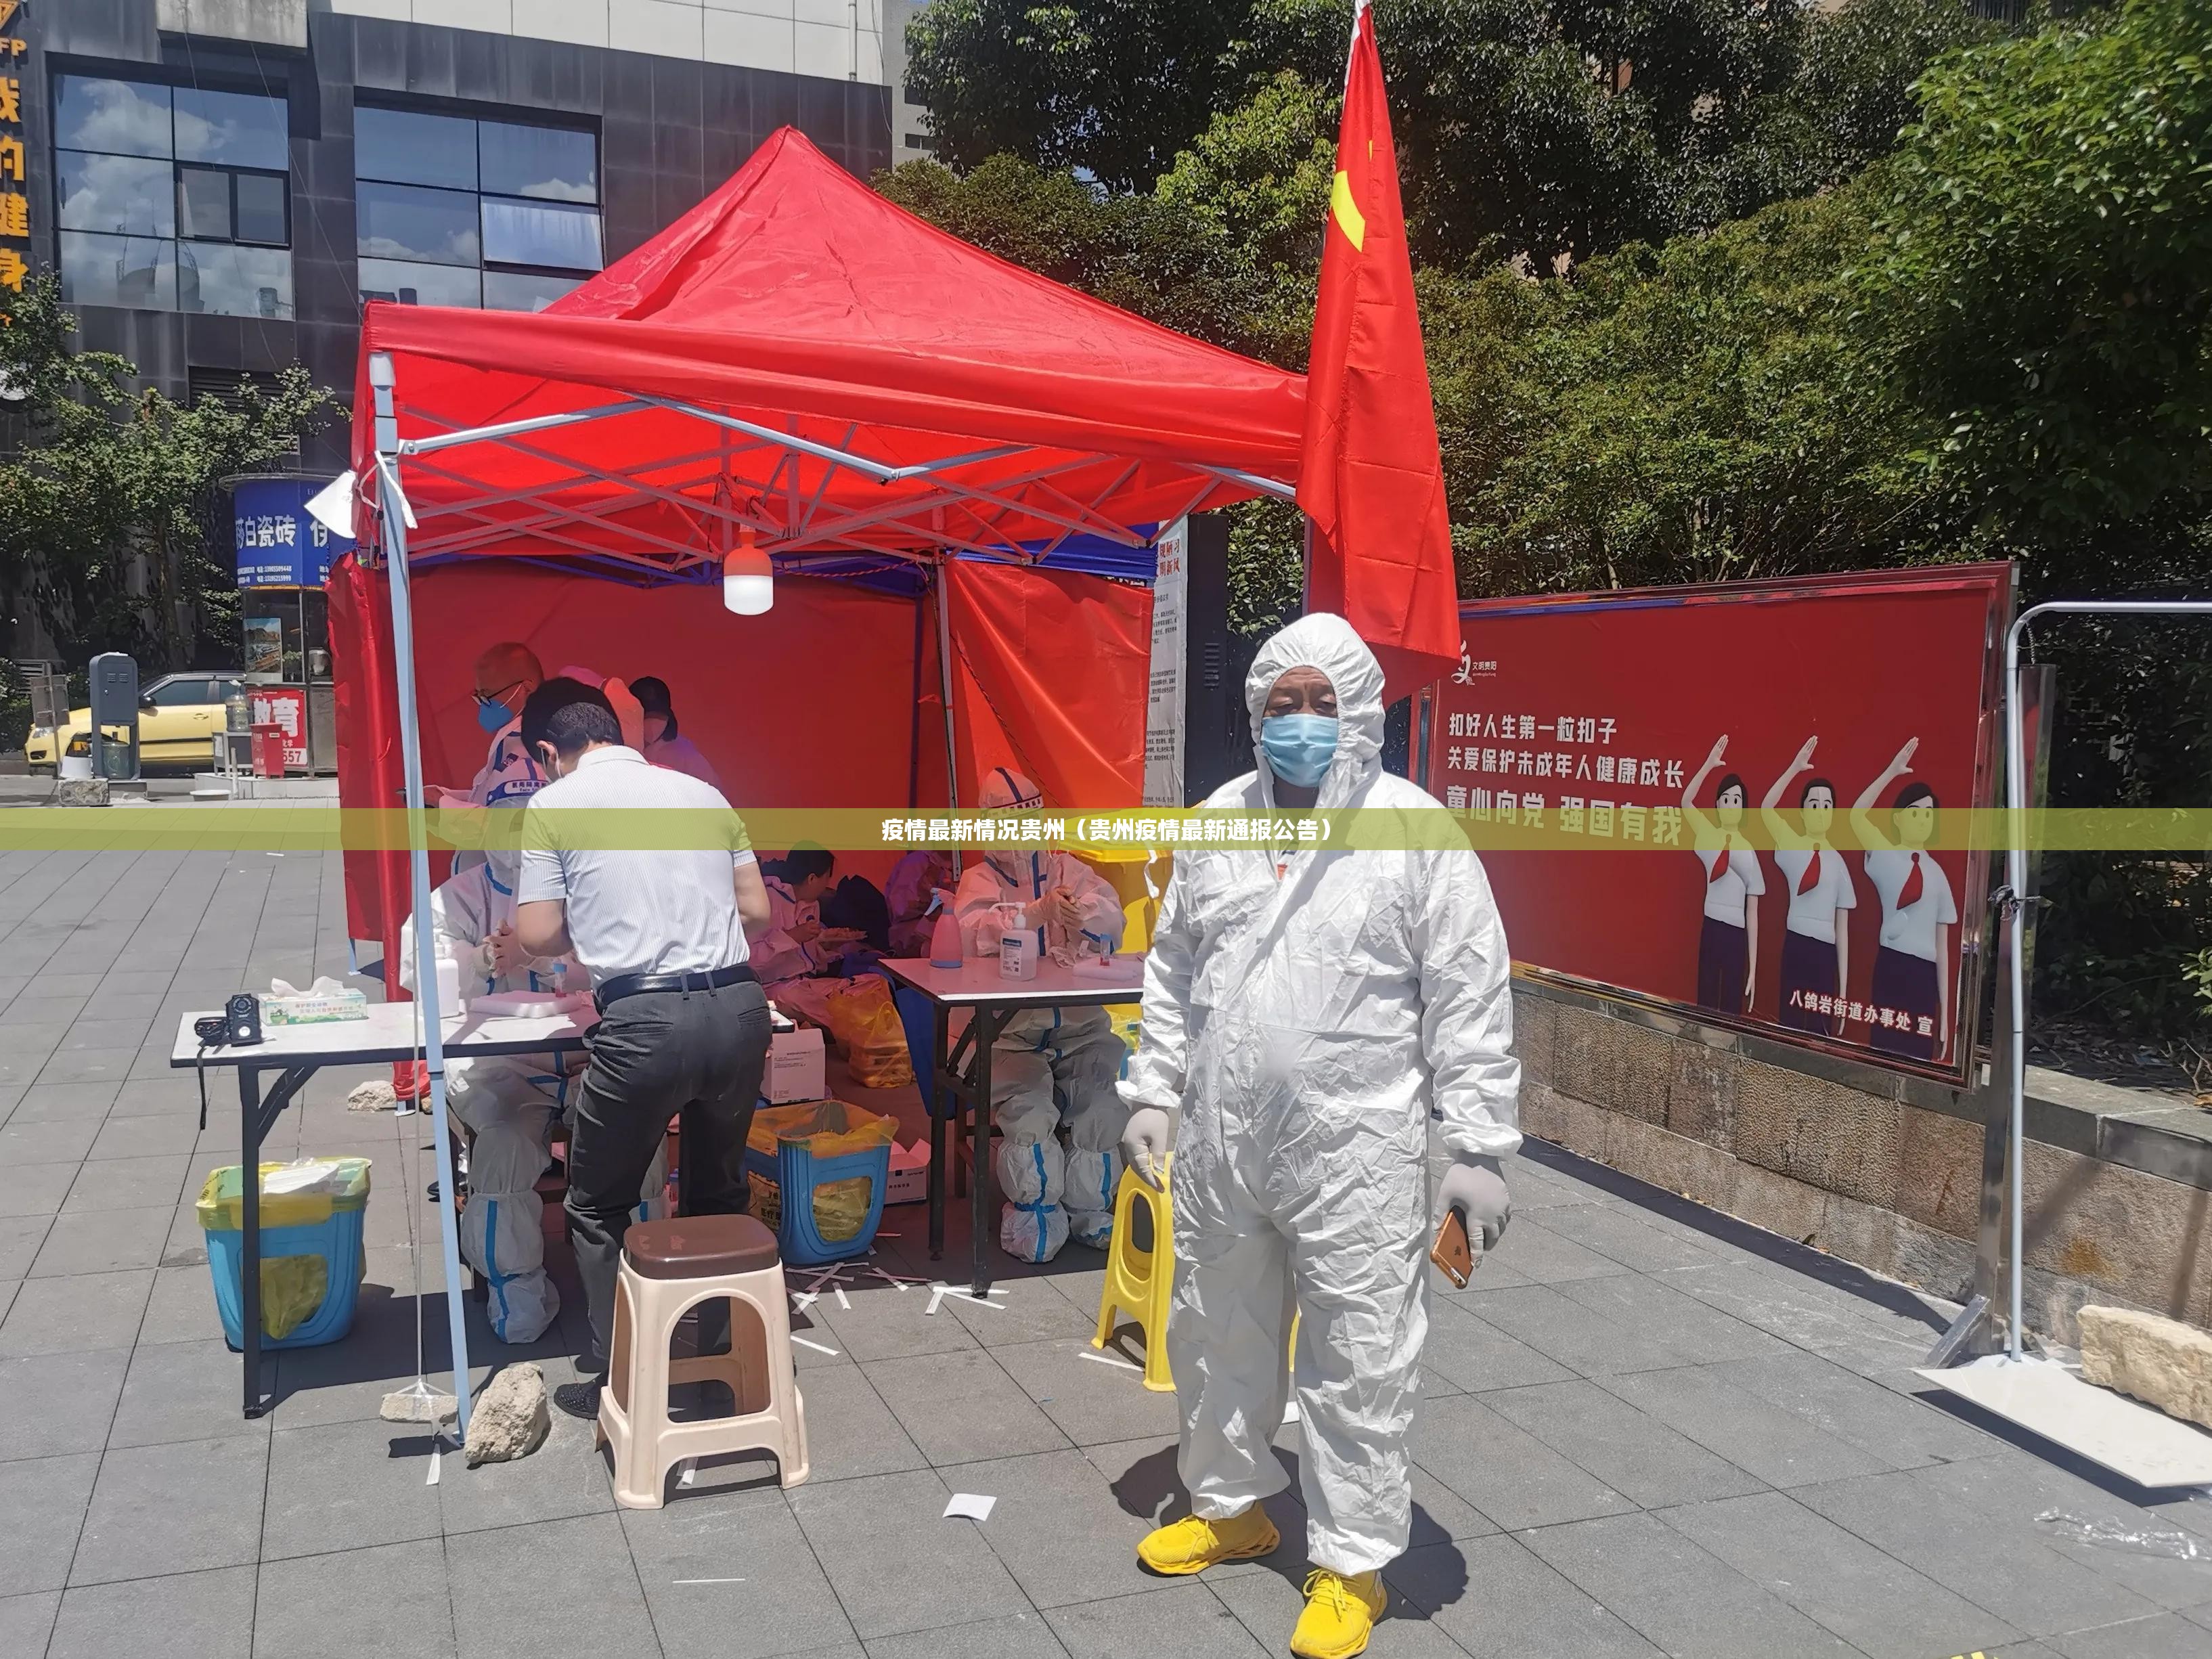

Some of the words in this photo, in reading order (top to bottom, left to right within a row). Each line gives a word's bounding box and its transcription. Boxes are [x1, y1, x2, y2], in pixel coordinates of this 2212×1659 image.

[1157, 558, 1180, 577] 明新风
[1448, 713, 1617, 745] 扣好人生第一粒扣子
[1446, 747, 1684, 789] 关爱保护未成年人健康成长
[1446, 785, 1545, 828] 童心向党
[1560, 795, 1683, 846] 强国有我
[1789, 989, 1912, 1032] 八鸽岩街道办事处
[1916, 1016, 1934, 1037] 宣
